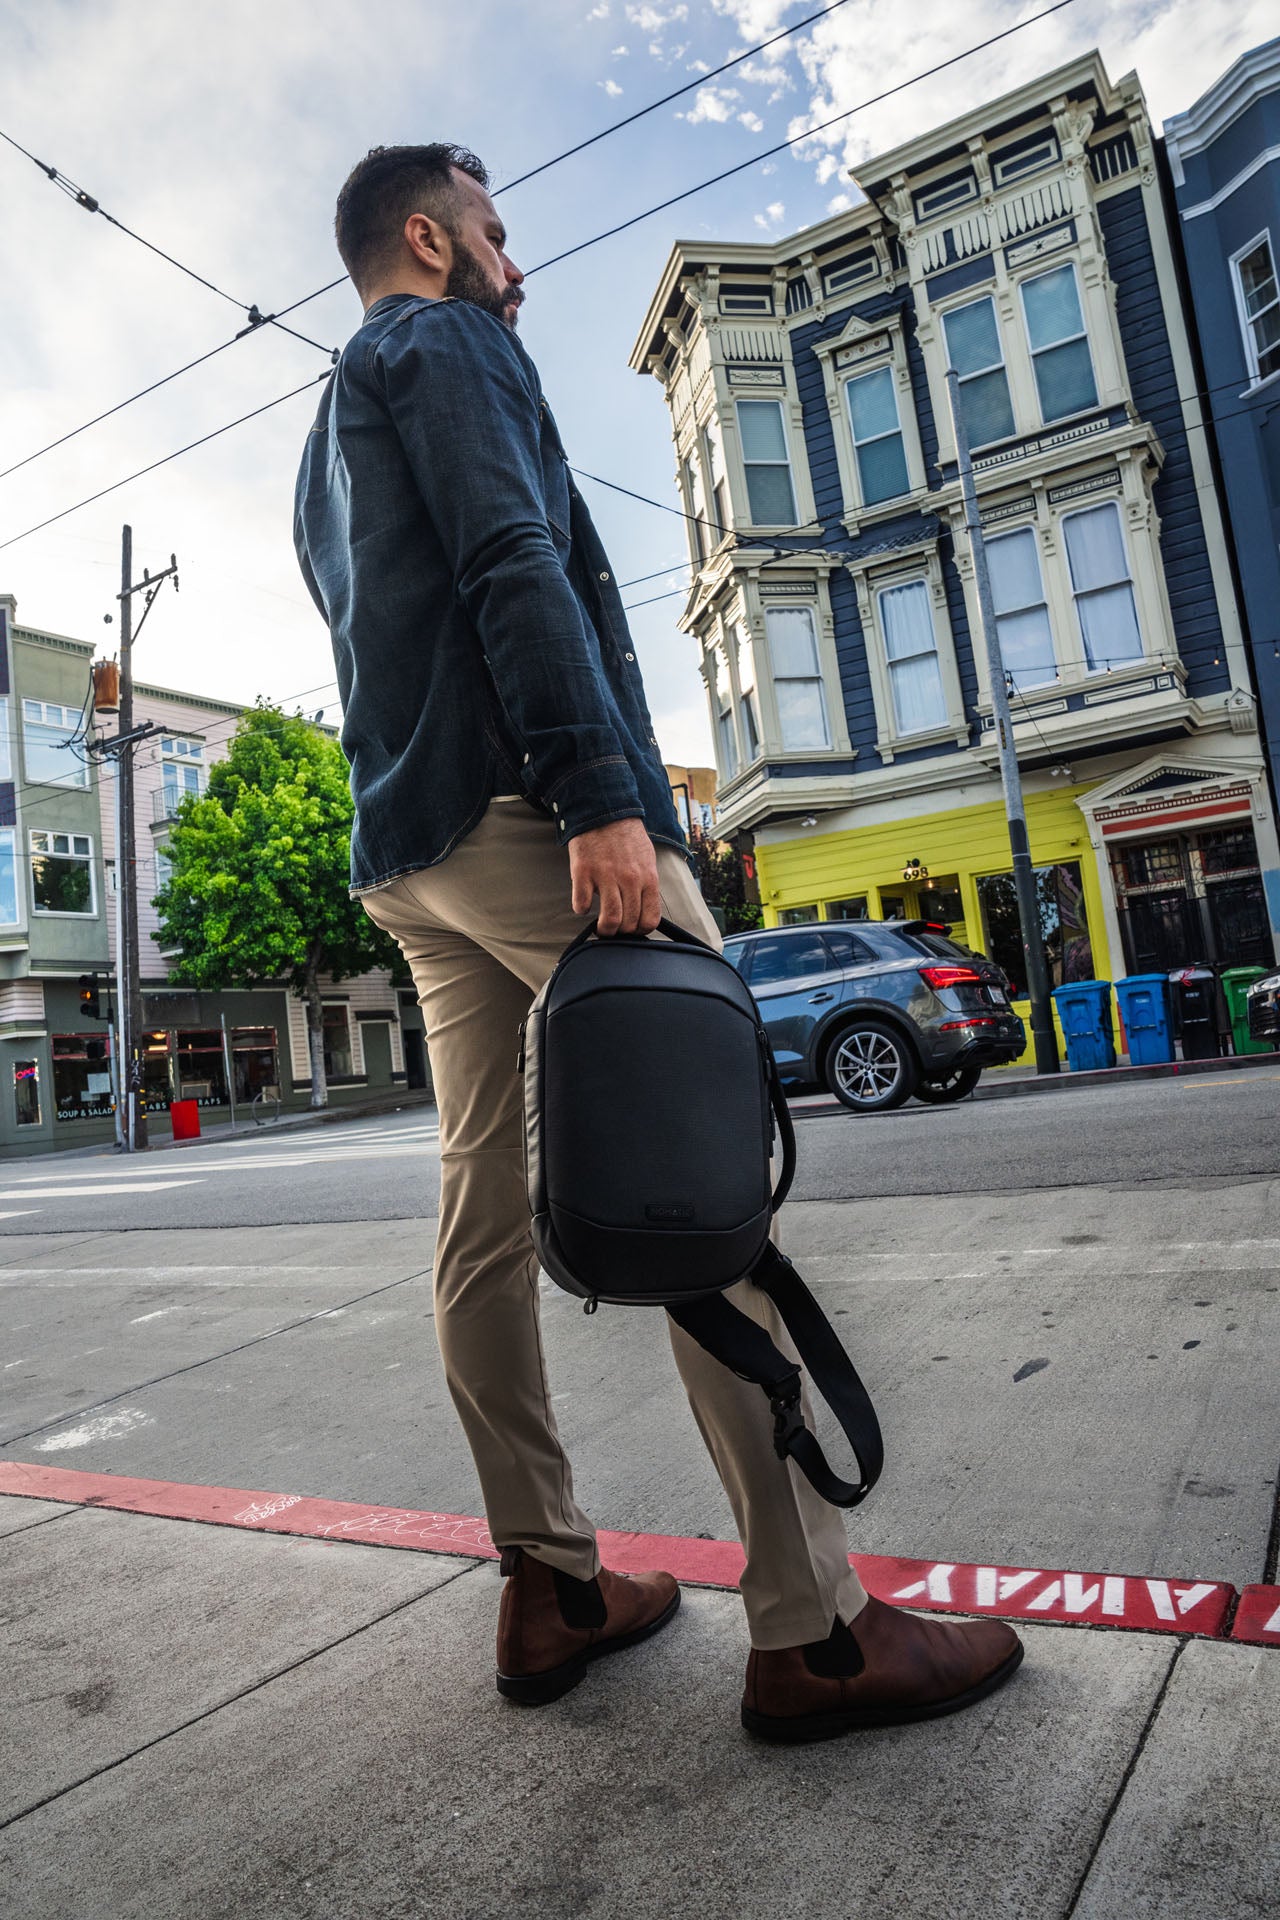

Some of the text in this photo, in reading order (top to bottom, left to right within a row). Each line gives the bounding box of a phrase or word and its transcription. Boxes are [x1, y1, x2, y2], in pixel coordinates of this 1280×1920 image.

[903, 867, 928, 880] 698
[145, 1102, 167, 1111] ABS
[198, 1097, 221, 1106] RAPS
[57, 1110, 79, 1119] SOUP
[80, 1109, 86, 1117] &
[893, 1563, 1218, 1621] AWAY
